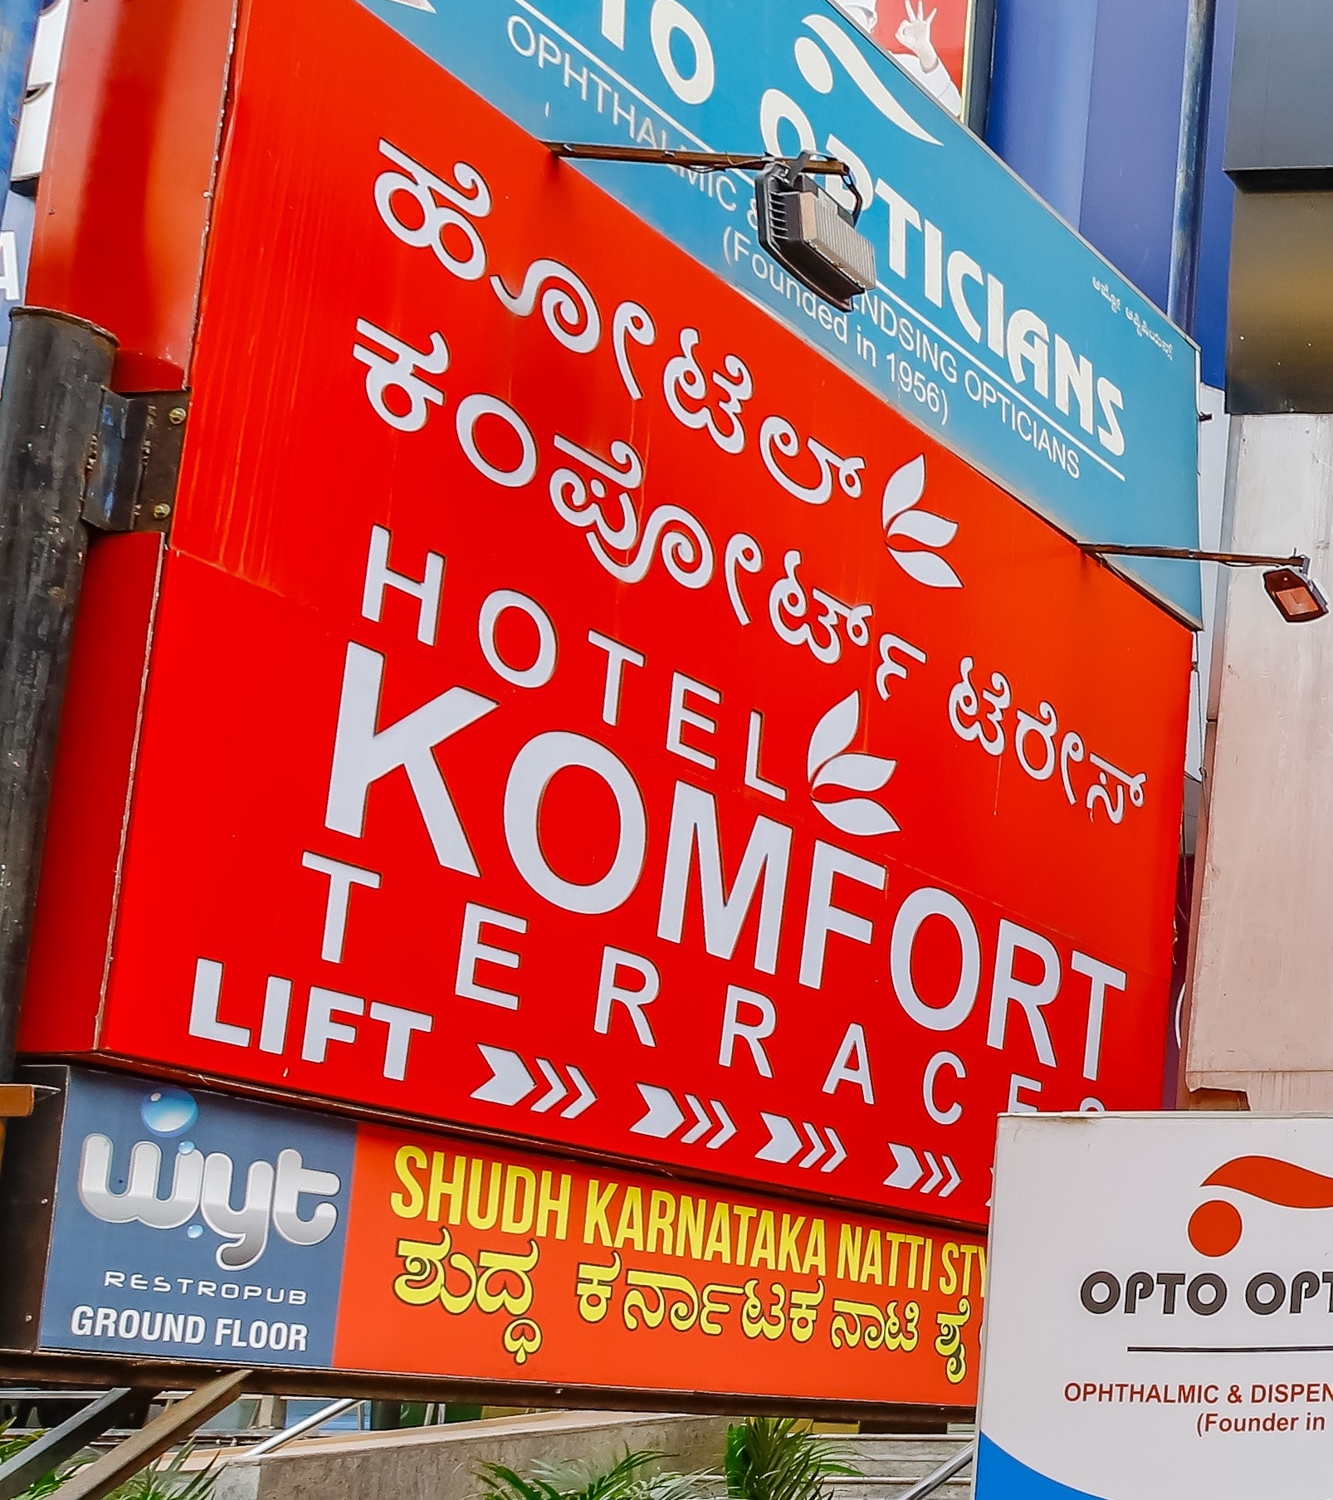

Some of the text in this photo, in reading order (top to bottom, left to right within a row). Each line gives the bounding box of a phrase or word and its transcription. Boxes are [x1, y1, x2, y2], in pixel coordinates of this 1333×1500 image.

[722, 226, 949, 425] (Founded in 1956)
[760, 88, 1125, 457] OPTICIANS
[853, 290, 957, 384] NDSING
[965, 370, 1079, 479] OPTICIANS
[360, 524, 788, 801] HOTEL
[325, 641, 1126, 1080] KOMFORT
[188, 958, 433, 1080] LIFT
[301, 852, 1106, 1113] TERRACE
[79, 1132, 341, 1271] wyt
[390, 1145, 572, 1239] SHUDH
[583, 1180, 827, 1277] KARNATAKA
[837, 1223, 933, 1292] NATTI
[70, 1305, 308, 1351] GROUND FLOOR
[103, 1270, 307, 1305] RESTROPUB
[1079, 1269, 1229, 1316] OPTO
[1064, 1381, 1219, 1405] OPHTHALMIC
[1226, 1383, 1243, 1405] &
[1196, 1411, 1300, 1437] (Founder
[1305, 1411, 1326, 1432] in
